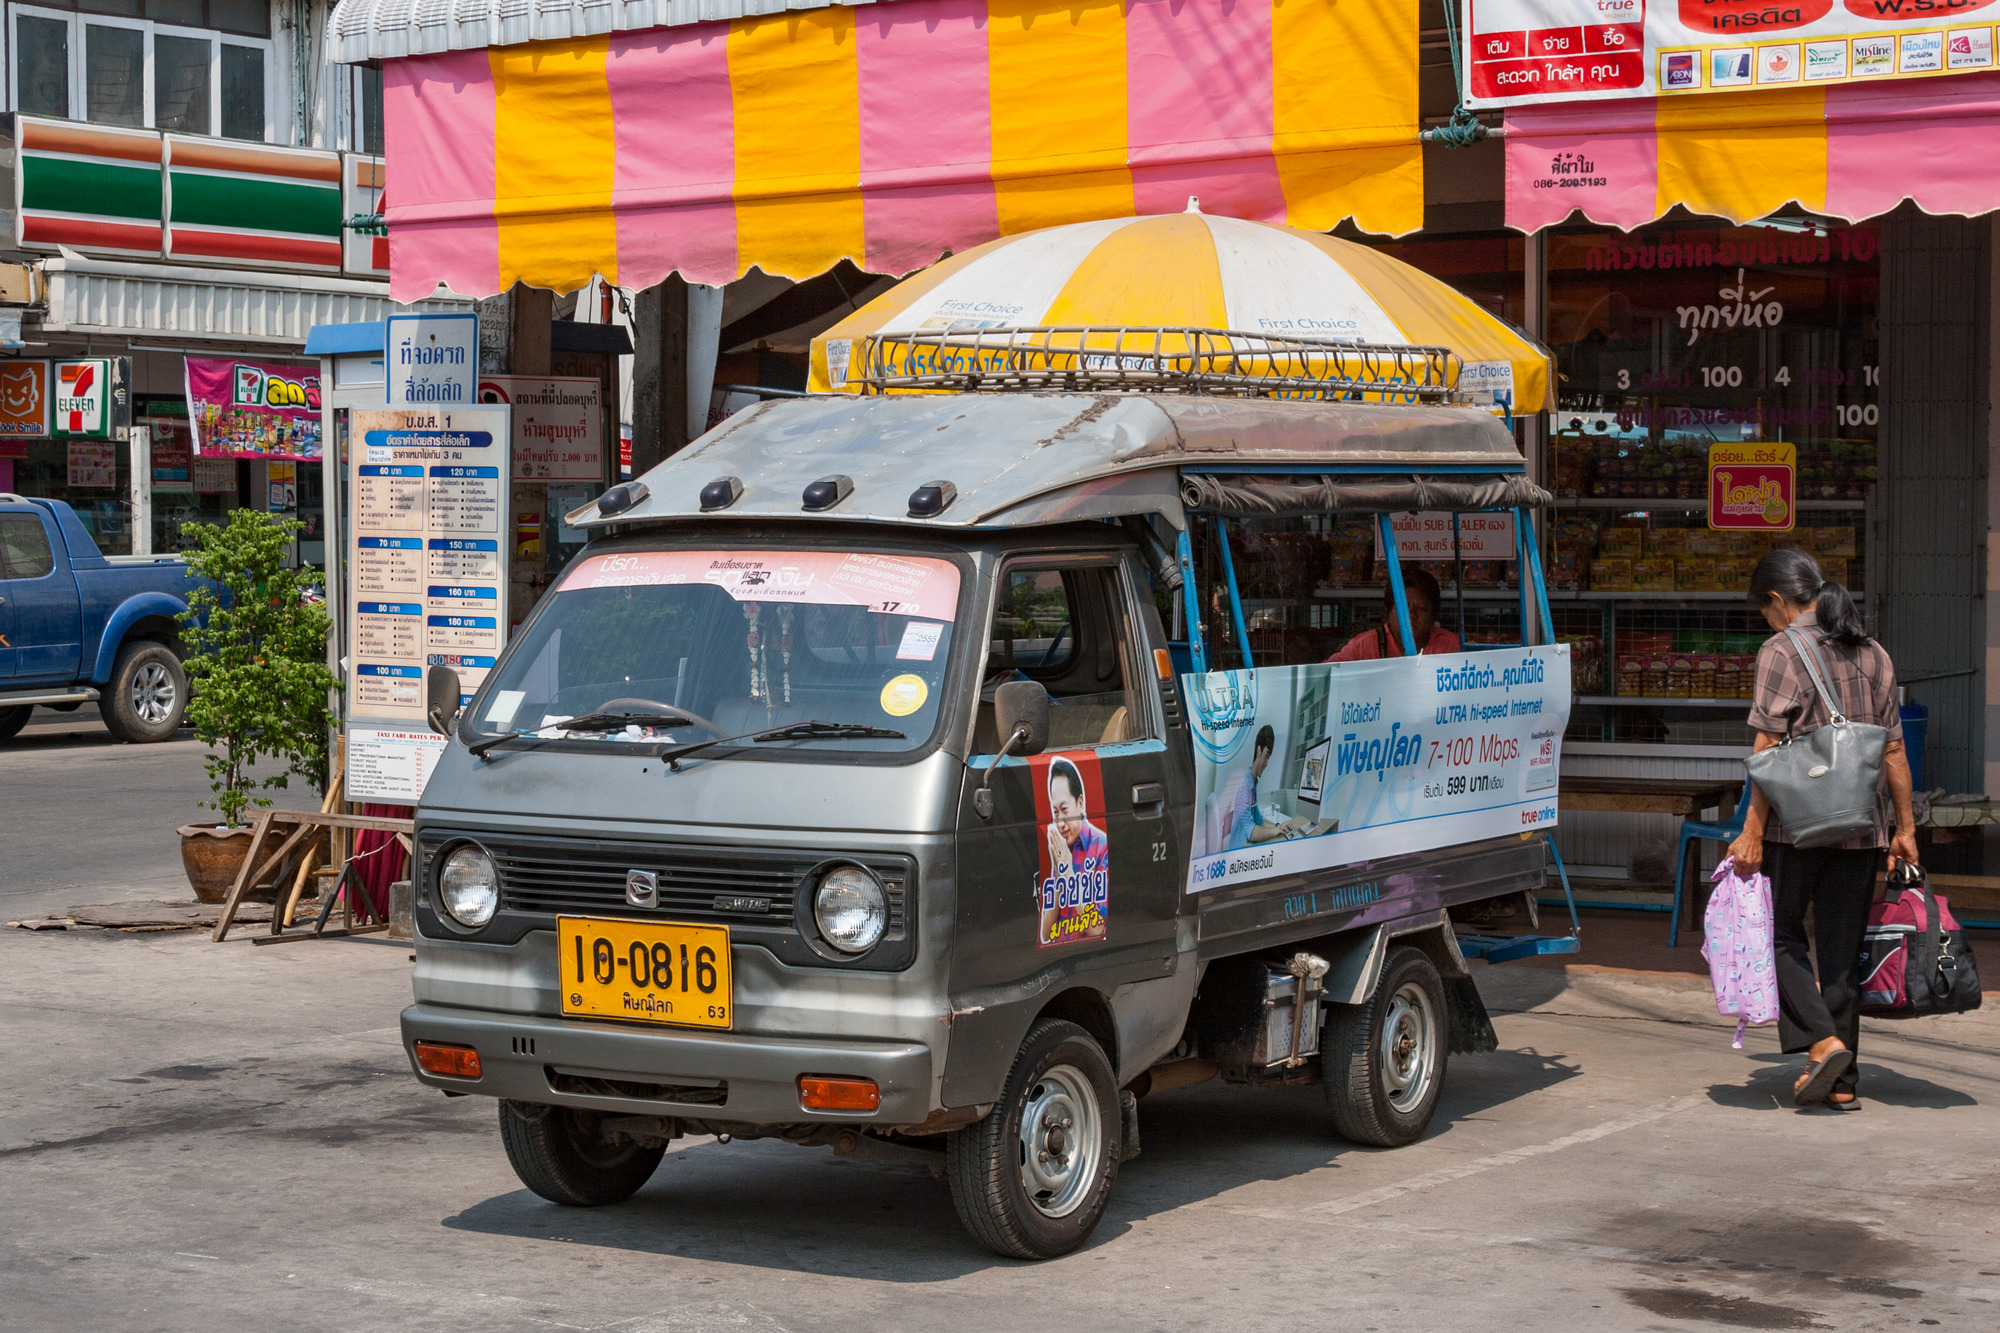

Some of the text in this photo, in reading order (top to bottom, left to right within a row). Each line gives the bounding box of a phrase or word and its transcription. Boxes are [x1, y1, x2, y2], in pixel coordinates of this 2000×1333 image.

[1597, 0, 1634, 11] true
[1713, 7, 1801, 29] เครดิต
[1543, 36, 1569, 51] จ่าย
[1602, 27, 1625, 46] ซื้อ
[1487, 40, 1510, 54] เติม
[1497, 63, 1619, 85] สะดวก ใกล้ๆ คุณ
[1669, 70, 1692, 80] AEON
[1840, 230, 1880, 263] 10
[941, 299, 1024, 314] First Choice
[1676, 268, 1783, 347] ทุกยี่ห้อ
[1258, 317, 1357, 329] First Choice
[400, 337, 465, 366] ที่จอดรถ
[1478, 363, 1511, 378] Choice
[1617, 368, 1631, 390] 3
[1701, 366, 1743, 388] 100
[1774, 366, 1791, 386] 4
[405, 375, 462, 403] สี่ล้อเล็ก
[516, 384, 598, 410] สถานที่นี้ปลอดบุหรี่
[406, 414, 451, 429] บ.ข.ส. 1
[1837, 404, 1879, 426] 100
[18, 421, 42, 433] Smile
[522, 412, 587, 444] ห้ามสูบบุหรี่
[386, 430, 470, 446] อัตราค่าโดยสารสี่ล้อเล็ก
[393, 448, 462, 460] ราคาเหมาไม่เกิน 3 คน
[562, 454, 581, 464] 2,000
[585, 453, 598, 463] บาท
[379, 467, 402, 475] 60 บาท
[450, 468, 478, 477] 120 บาท
[1424, 519, 1506, 531] SUB DALER ของ
[379, 539, 388, 547] 70
[449, 541, 463, 549] 150
[1401, 541, 1422, 551] หจก.
[600, 555, 650, 573] มีรถ...
[464, 589, 476, 597] บาท
[378, 604, 400, 613] 80 บาท
[882, 601, 920, 614] 1770
[448, 617, 476, 627] 180 บาท
[917, 634, 937, 643] 2555
[445, 655, 475, 666] 180 บาท
[376, 667, 402, 676] 100 บาท
[1436, 657, 1544, 694] ชีวิตที่ดีกว่า...คุณก็มีได้
[1194, 685, 1255, 714] ULTRA
[1341, 698, 1381, 725] ใช้ได้แล้วที่
[1436, 699, 1543, 725] ULTRA hi-speed Internet
[1201, 716, 1255, 732] hi-speed Internet
[1337, 722, 1422, 782] พิษณุโลก
[1427, 734, 1521, 770] 7-100 Mbps.
[1540, 738, 1553, 756] ฟรี!
[1423, 784, 1444, 799] เริ่มต้น
[1446, 777, 1466, 794] 599
[1521, 805, 1556, 825] true online
[1152, 842, 1167, 861] 22
[1228, 849, 1274, 876] สมัครเลยวันนี้
[1042, 856, 1107, 910] ธวัชชัย
[1049, 903, 1105, 940] มาแล้ว..
[575, 935, 717, 995] 10-0816
[622, 992, 674, 1018] พิษณุโลก
[707, 1004, 726, 1020] 63
